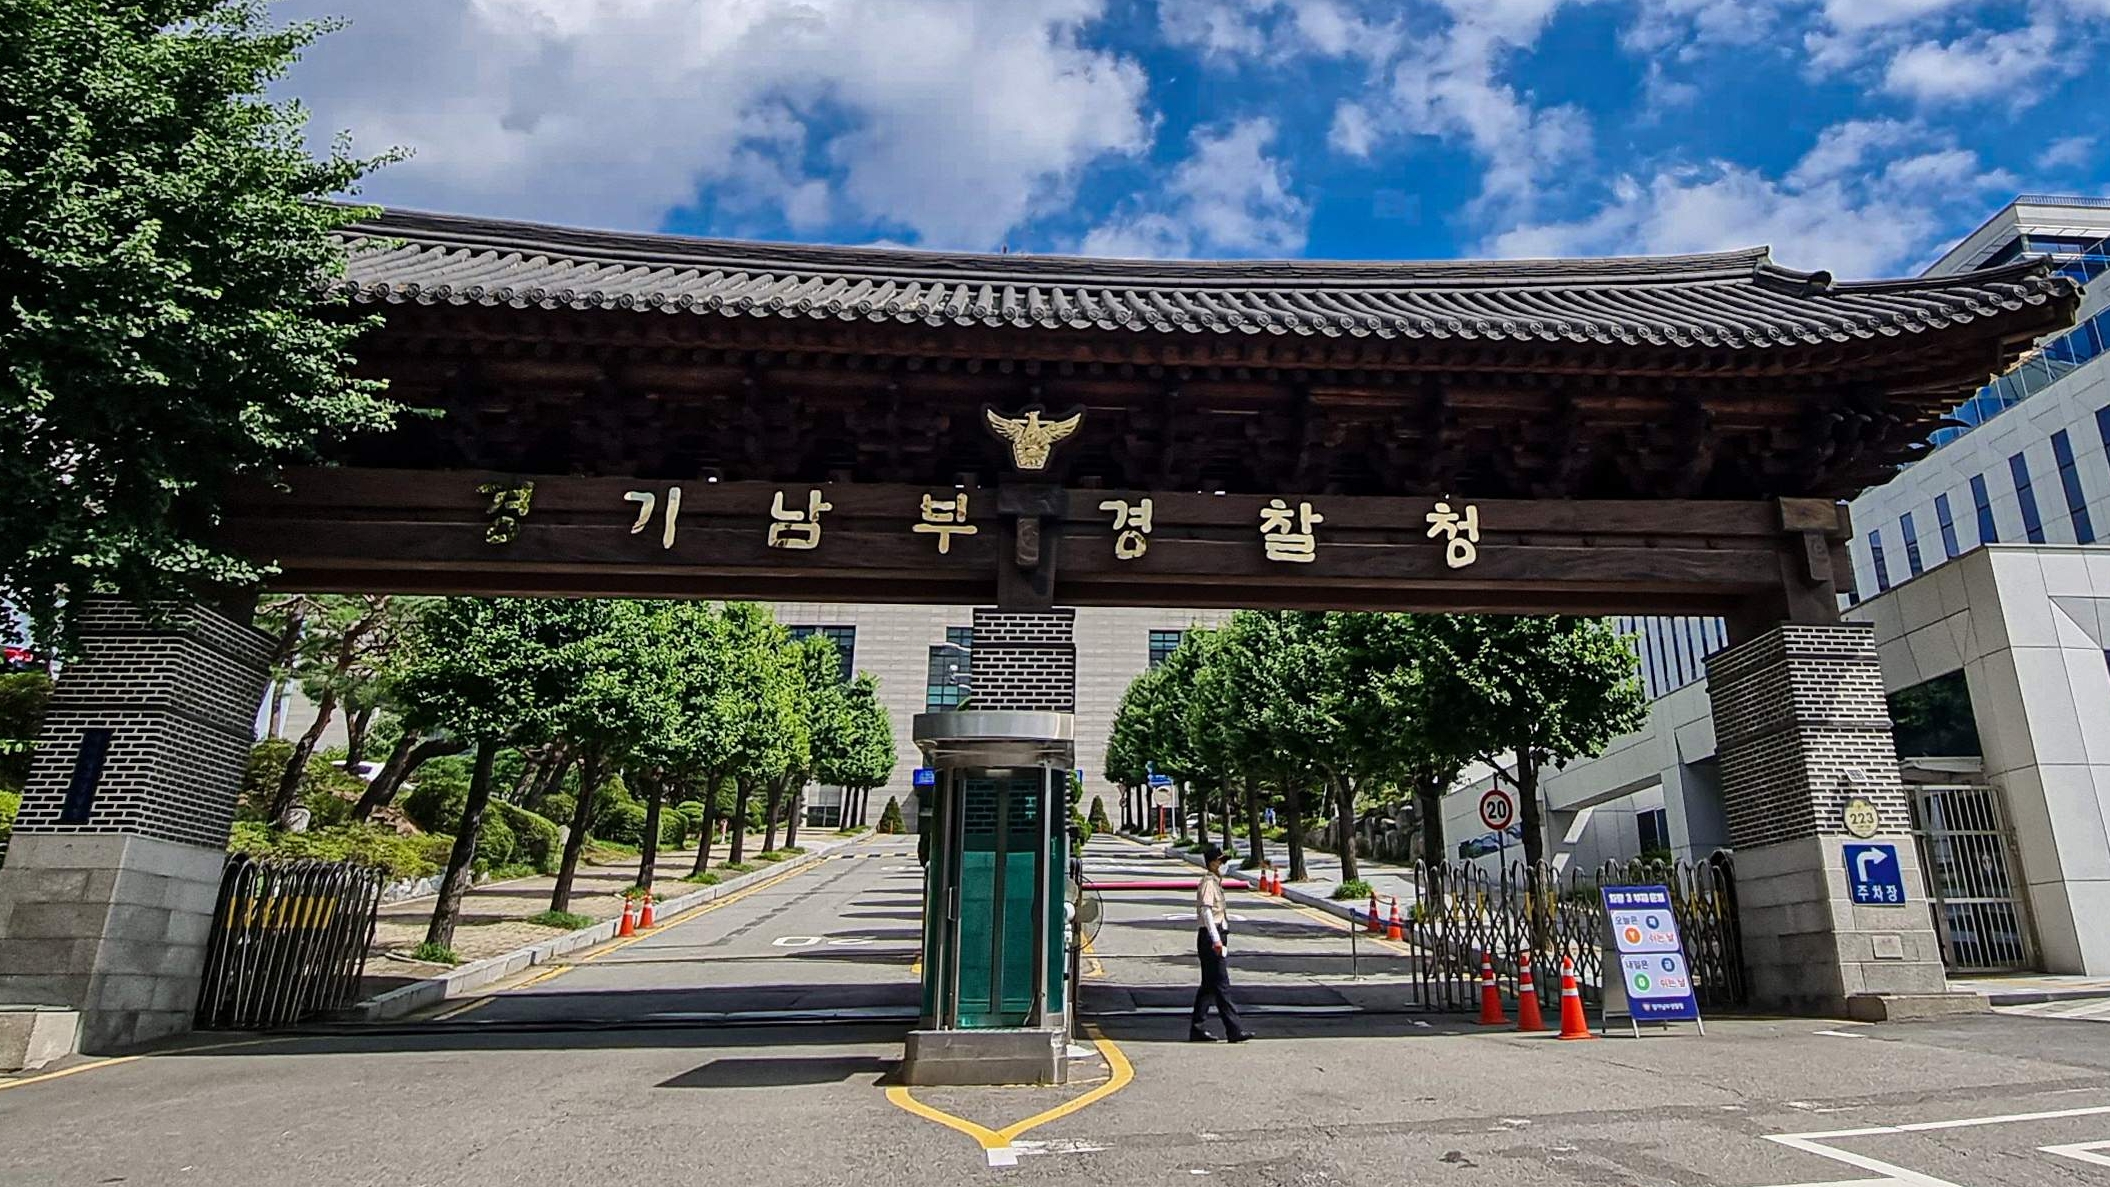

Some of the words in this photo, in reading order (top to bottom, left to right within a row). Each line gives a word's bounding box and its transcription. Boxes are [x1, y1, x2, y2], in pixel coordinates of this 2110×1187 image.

[1486, 799, 1507, 819] 20
[1849, 812, 1874, 825] 223
[1857, 885, 1898, 901] 주차장
